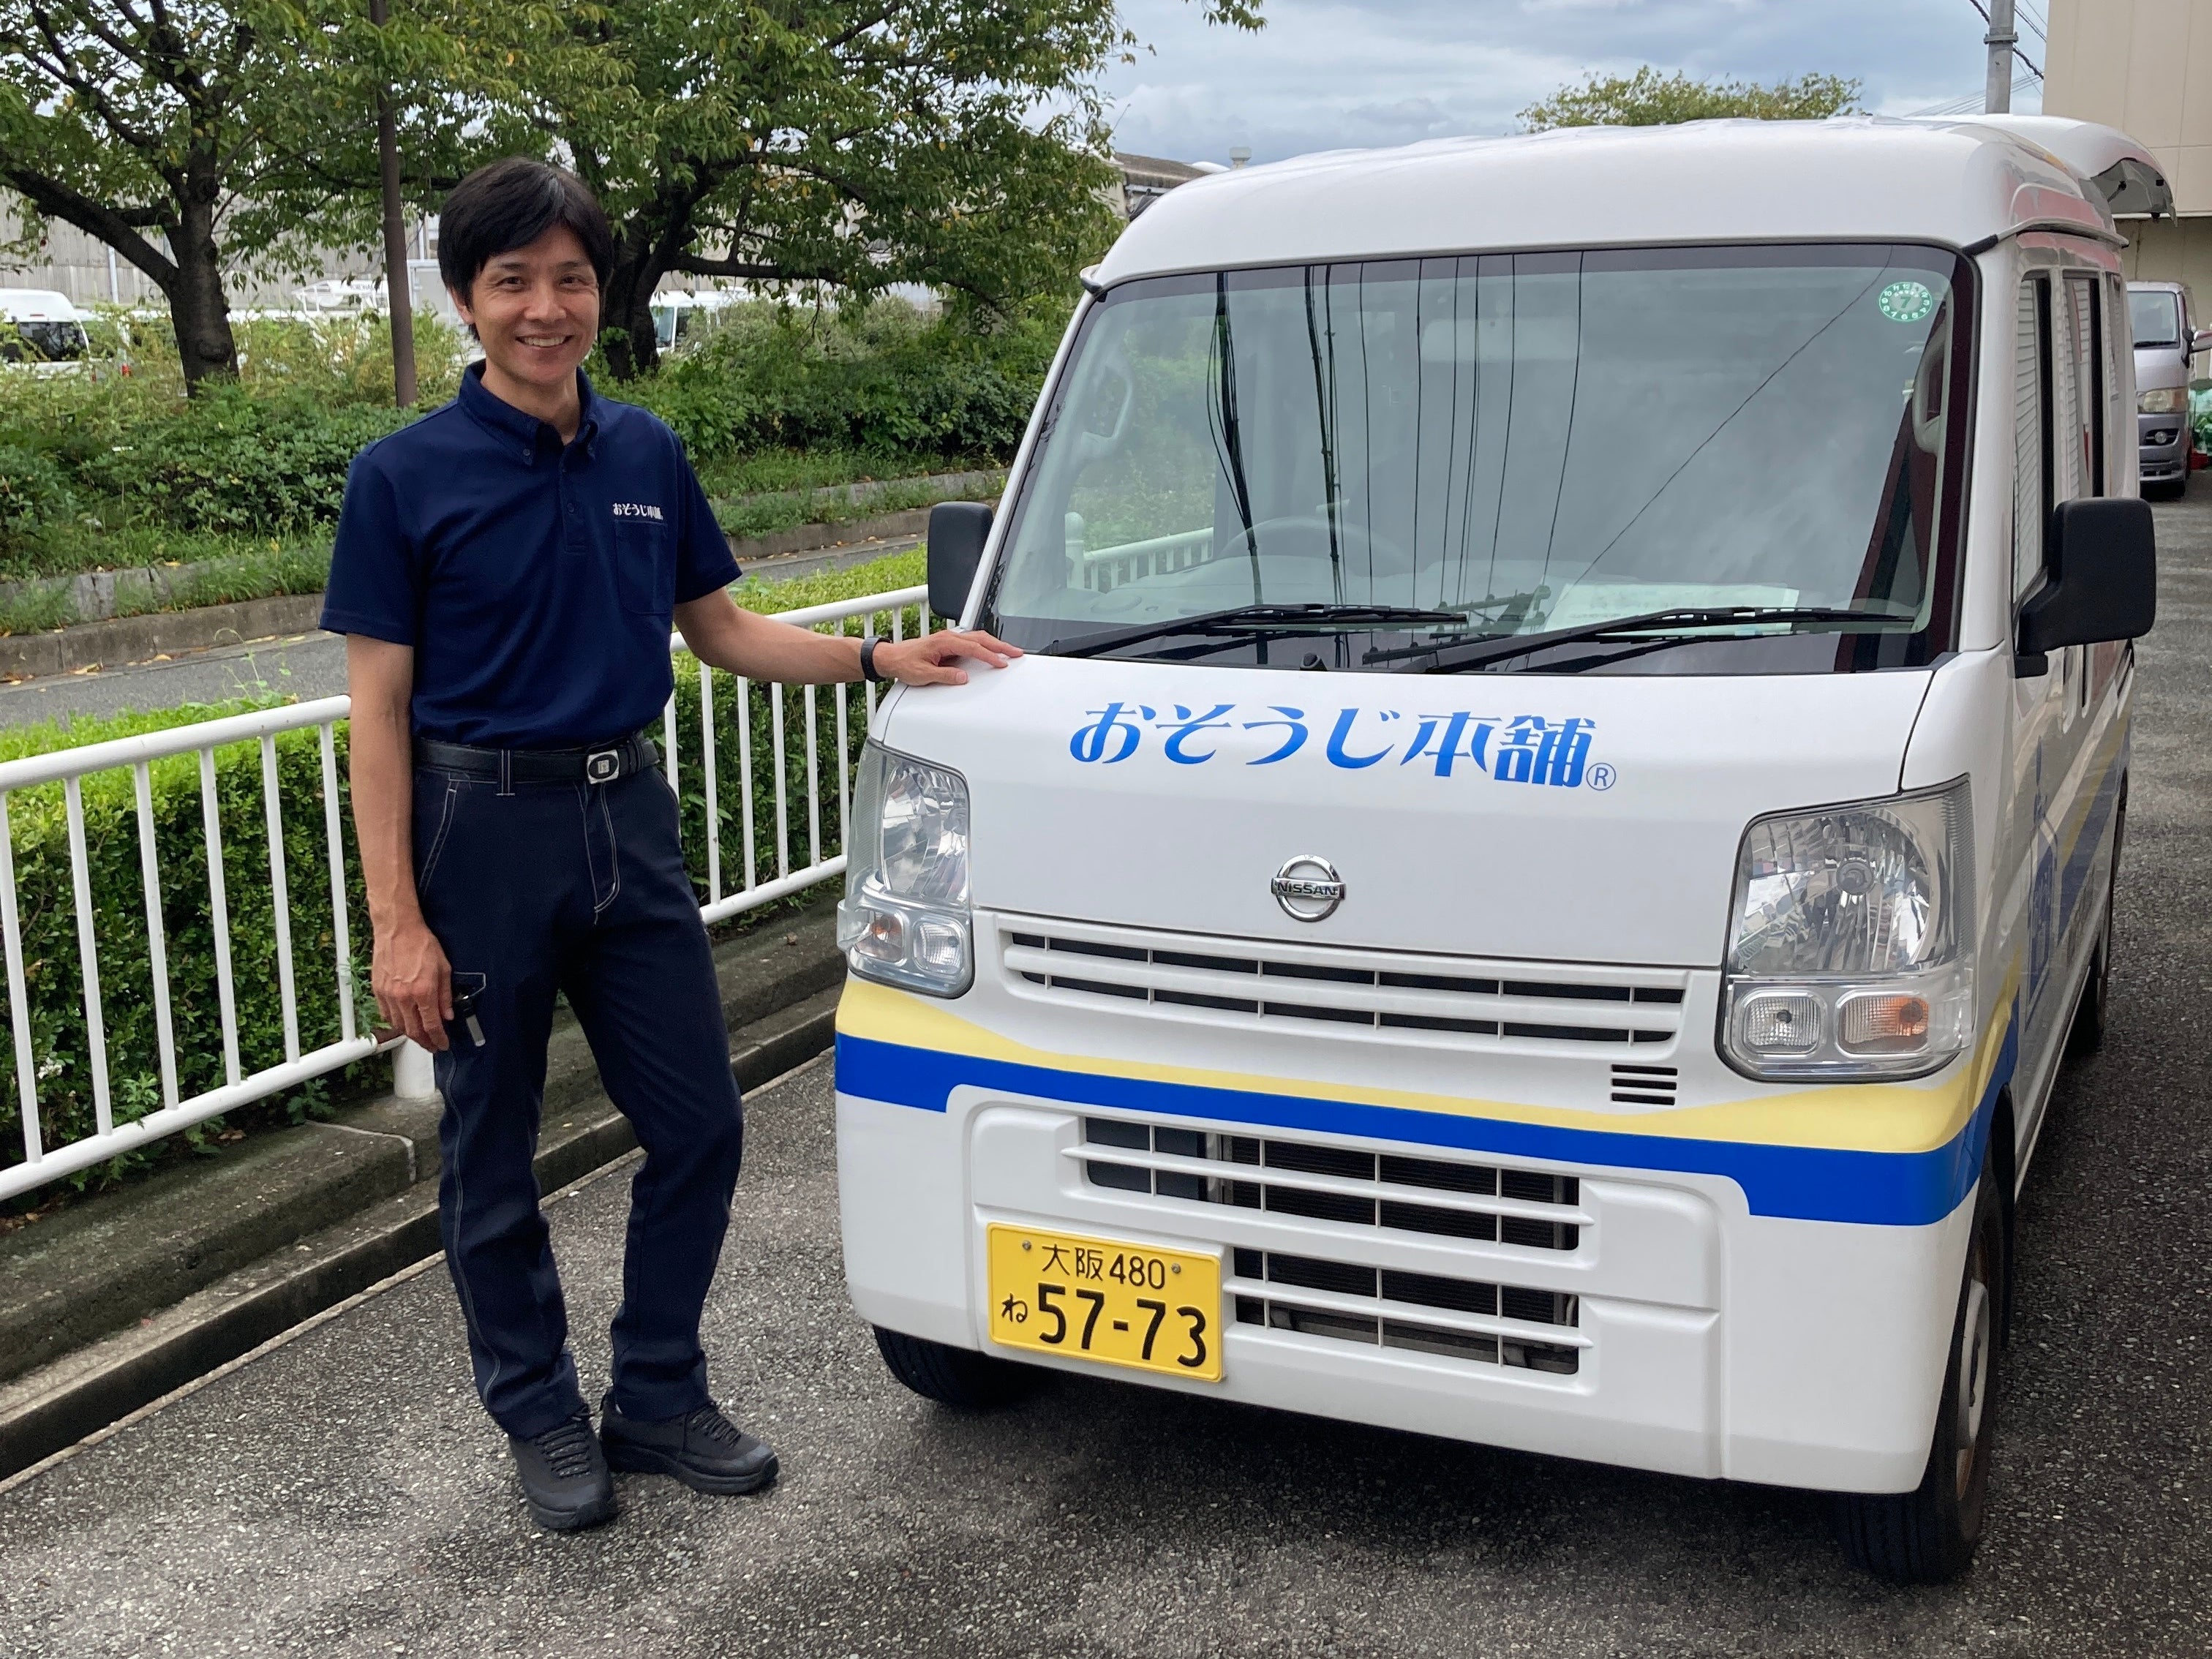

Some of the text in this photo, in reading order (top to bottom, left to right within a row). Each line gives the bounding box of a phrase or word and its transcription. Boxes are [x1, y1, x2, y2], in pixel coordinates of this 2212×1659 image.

[1900, 296, 1911, 309] 7
[1276, 881, 1337, 896] NISSAN
[1001, 1282, 1207, 1368] ね 57-73
